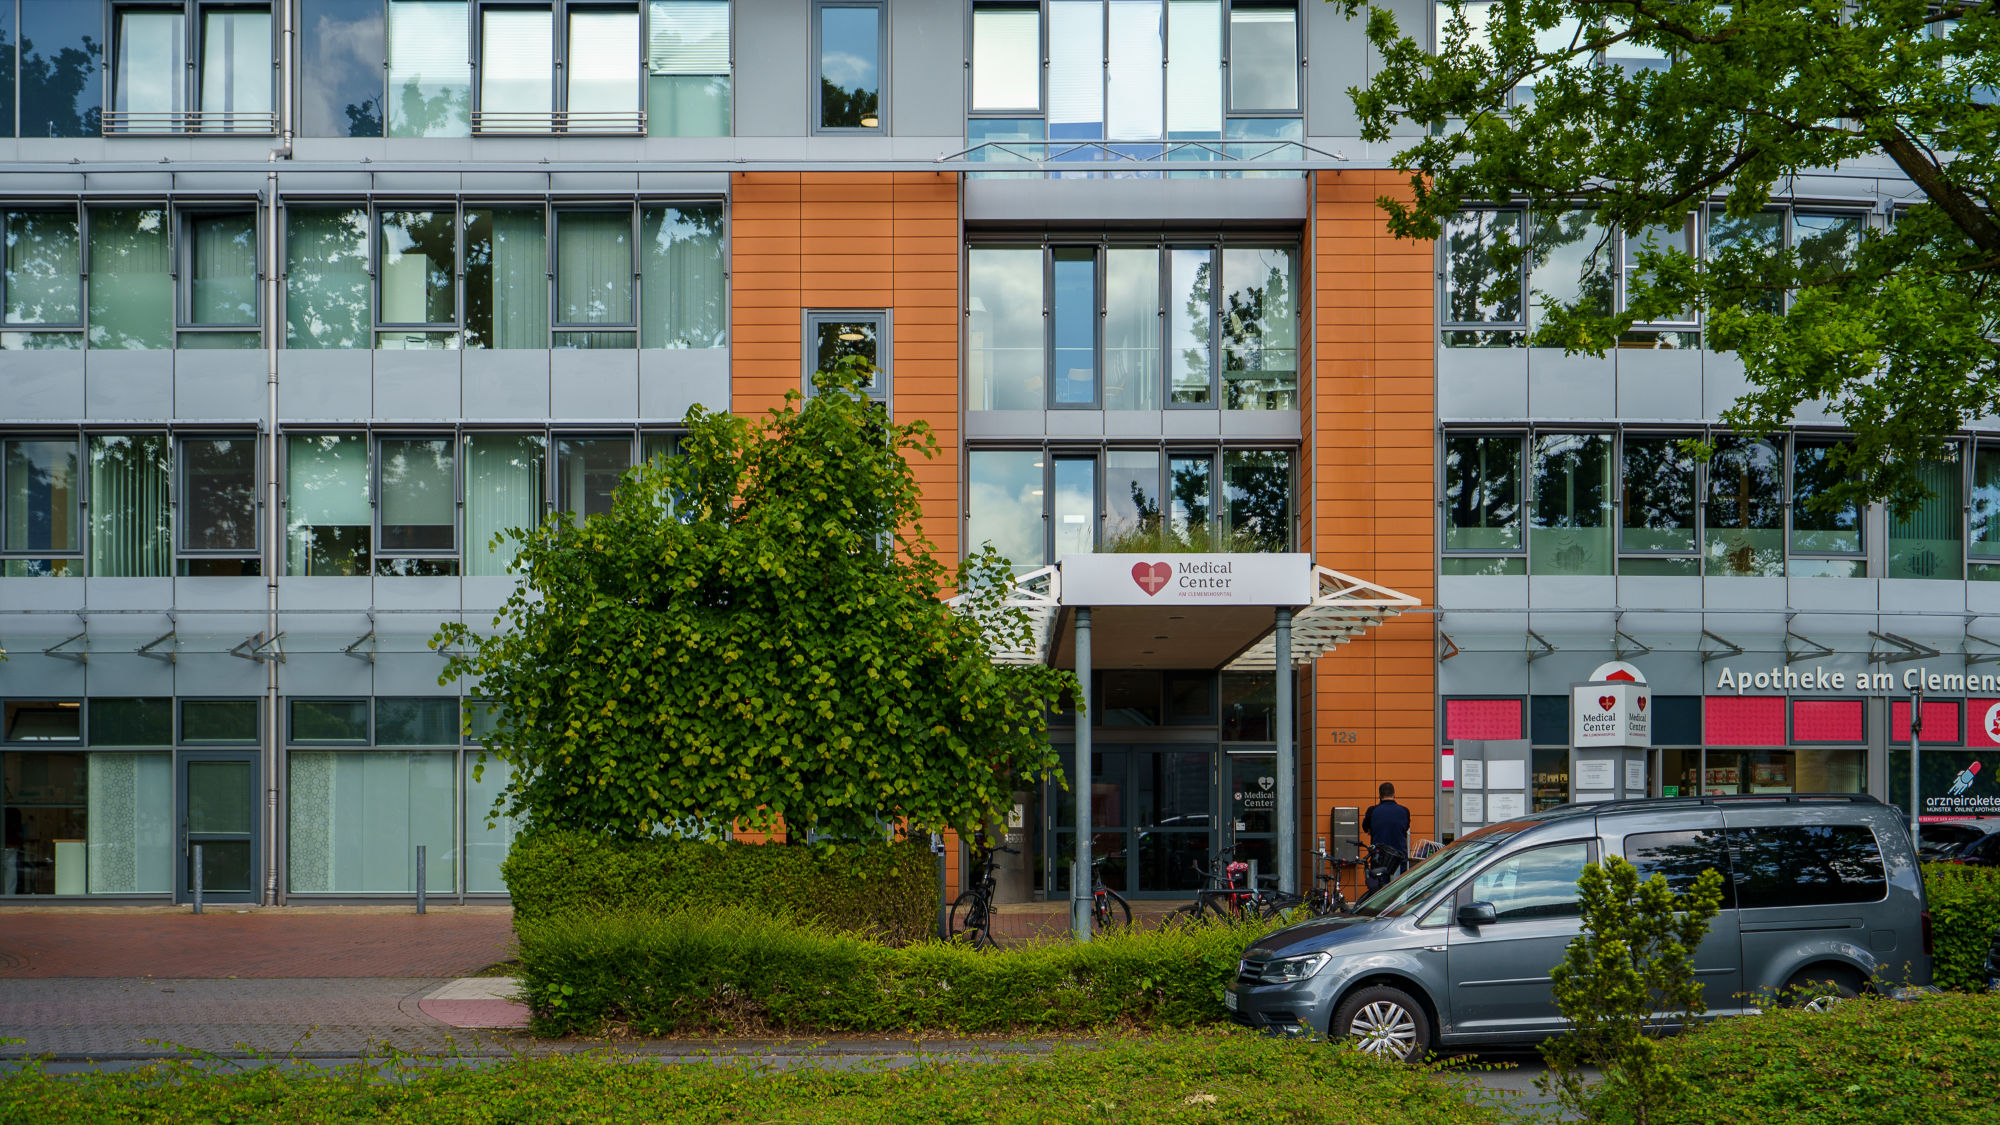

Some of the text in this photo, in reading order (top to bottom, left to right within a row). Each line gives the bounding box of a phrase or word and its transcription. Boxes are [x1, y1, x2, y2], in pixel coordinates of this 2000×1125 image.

[1178, 561, 1233, 574] Medical
[1179, 576, 1232, 588] Center
[1717, 666, 1845, 695] Apotheke
[1856, 671, 1894, 690] am
[1583, 712, 1616, 722] Medical
[1628, 712, 1647, 722] Medical
[1583, 722, 1616, 732] Center
[1629, 722, 1647, 732] Center
[1331, 730, 1357, 743] 128
[1244, 791, 1274, 799] Medical
[1244, 799, 1274, 807] Center
[1926, 795, 2000, 806] arzneirakete
